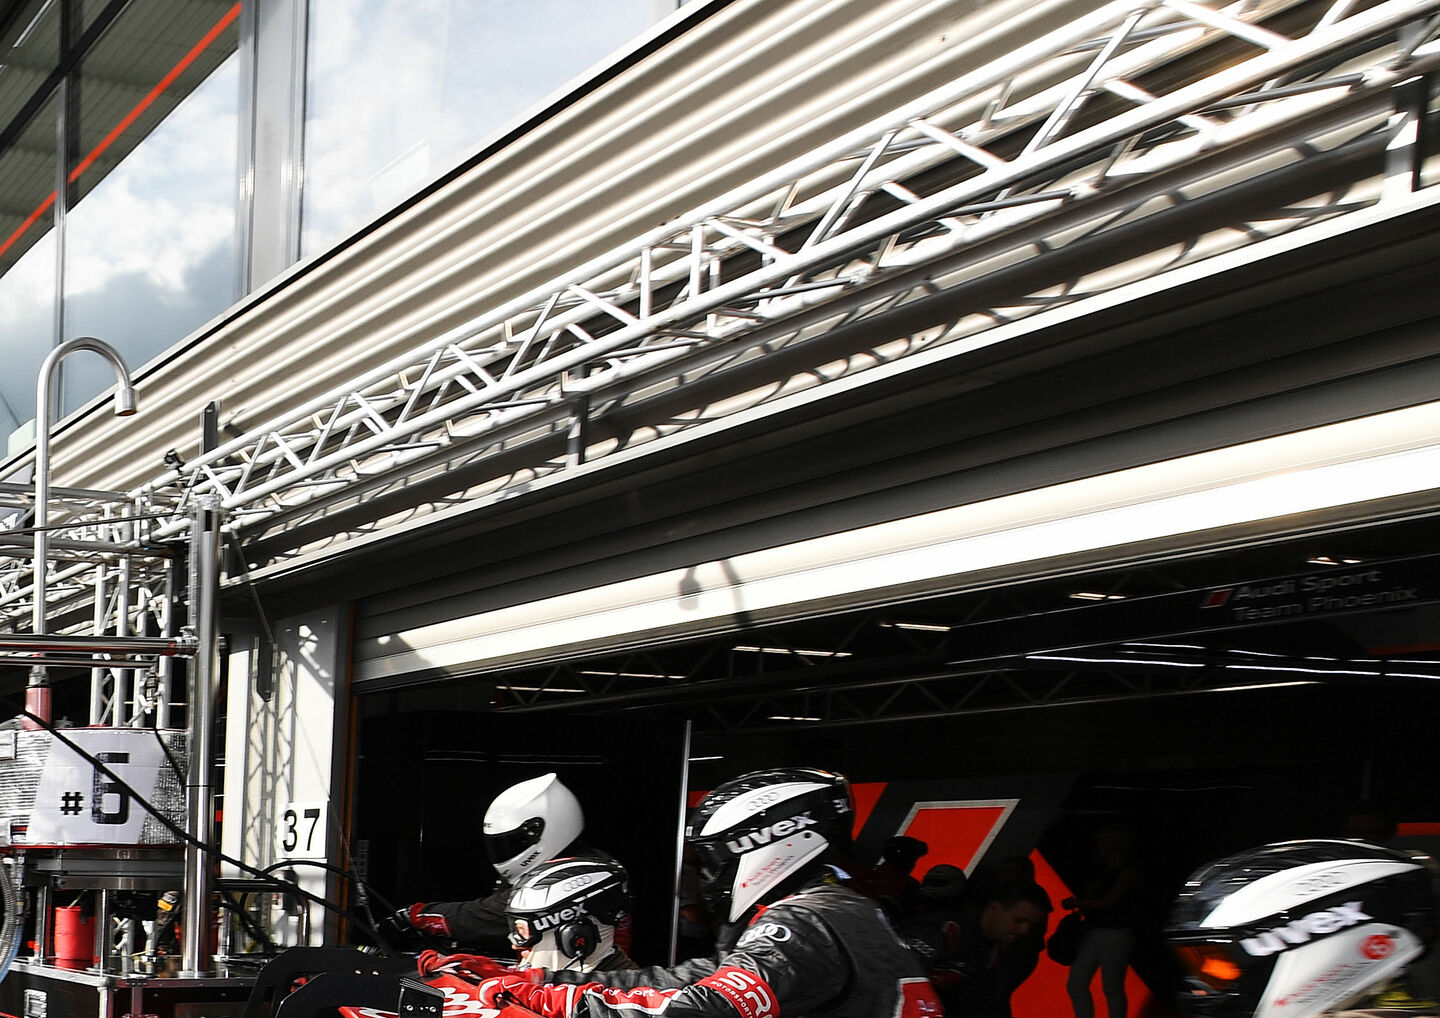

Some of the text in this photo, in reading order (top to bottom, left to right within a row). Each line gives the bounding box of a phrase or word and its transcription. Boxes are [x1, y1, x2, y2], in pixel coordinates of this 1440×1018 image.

[282, 808, 321, 852] 37
[725, 811, 819, 854] uvex
[533, 902, 589, 931] uvex
[1239, 901, 1375, 957] uvex
